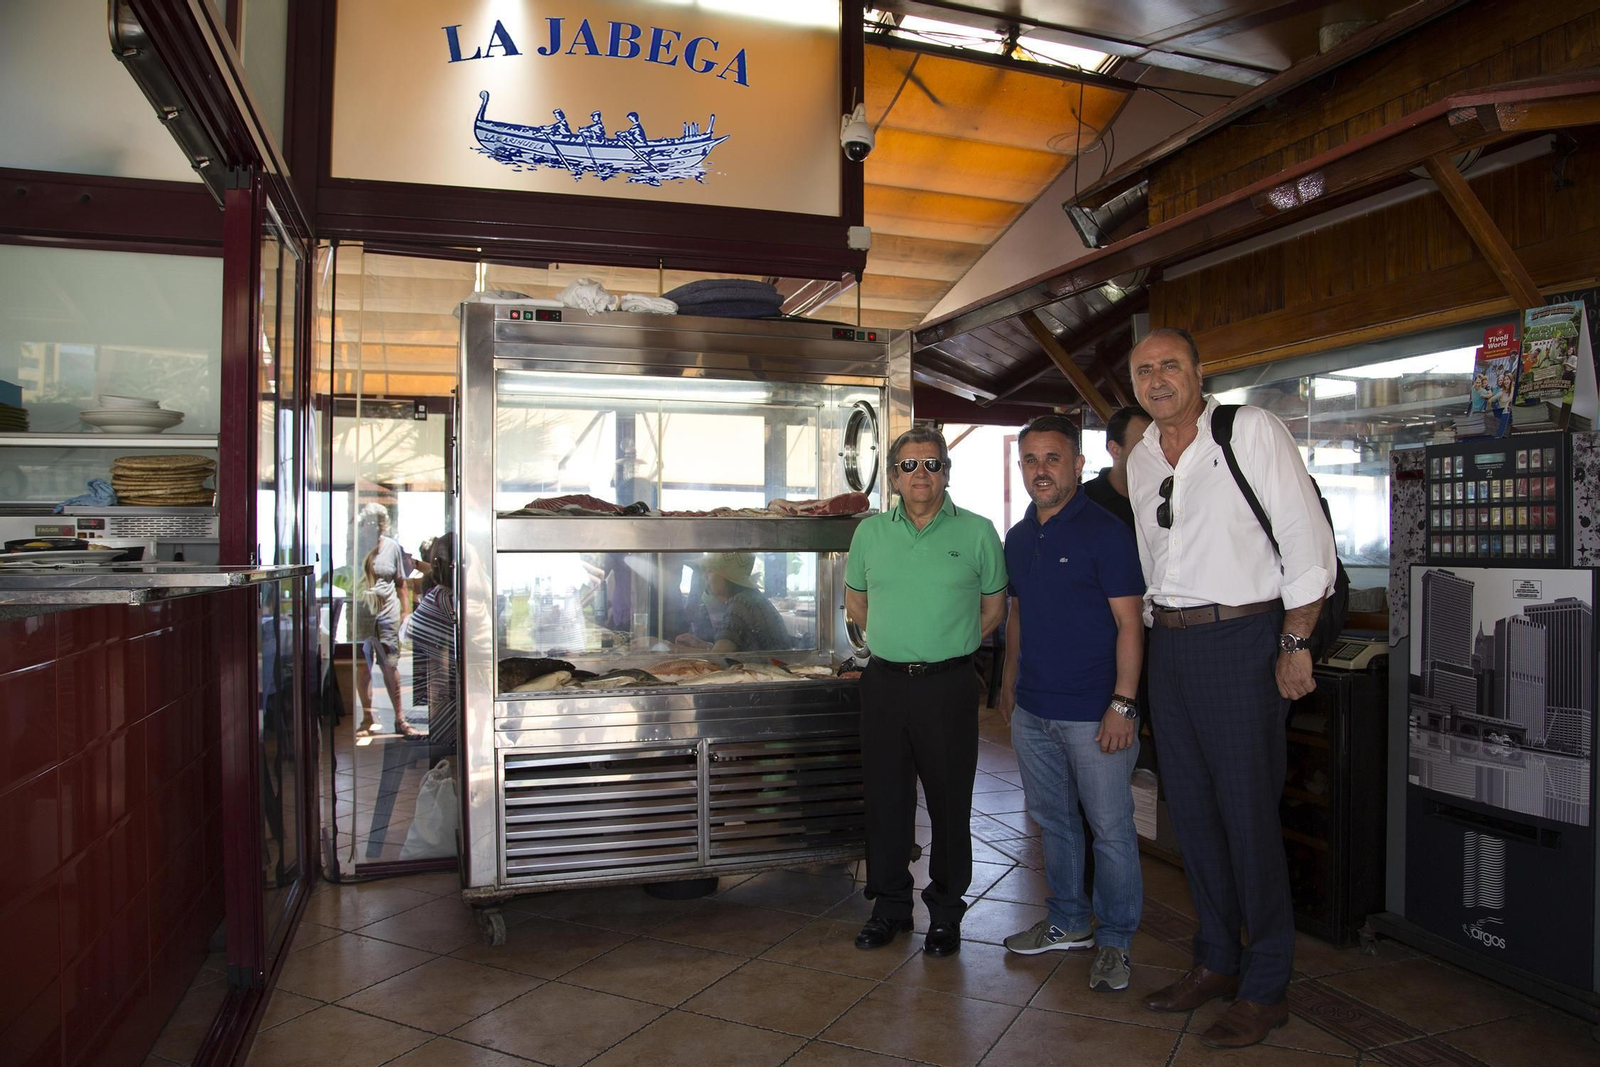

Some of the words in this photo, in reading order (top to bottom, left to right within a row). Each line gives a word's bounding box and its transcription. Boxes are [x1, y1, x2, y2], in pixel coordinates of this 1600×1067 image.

[441, 19, 523, 63] LA
[537, 17, 751, 87] JABEGA
[1487, 340, 1508, 349] World
[1488, 333, 1509, 343] Tivoli
[1471, 927, 1506, 949] argos
